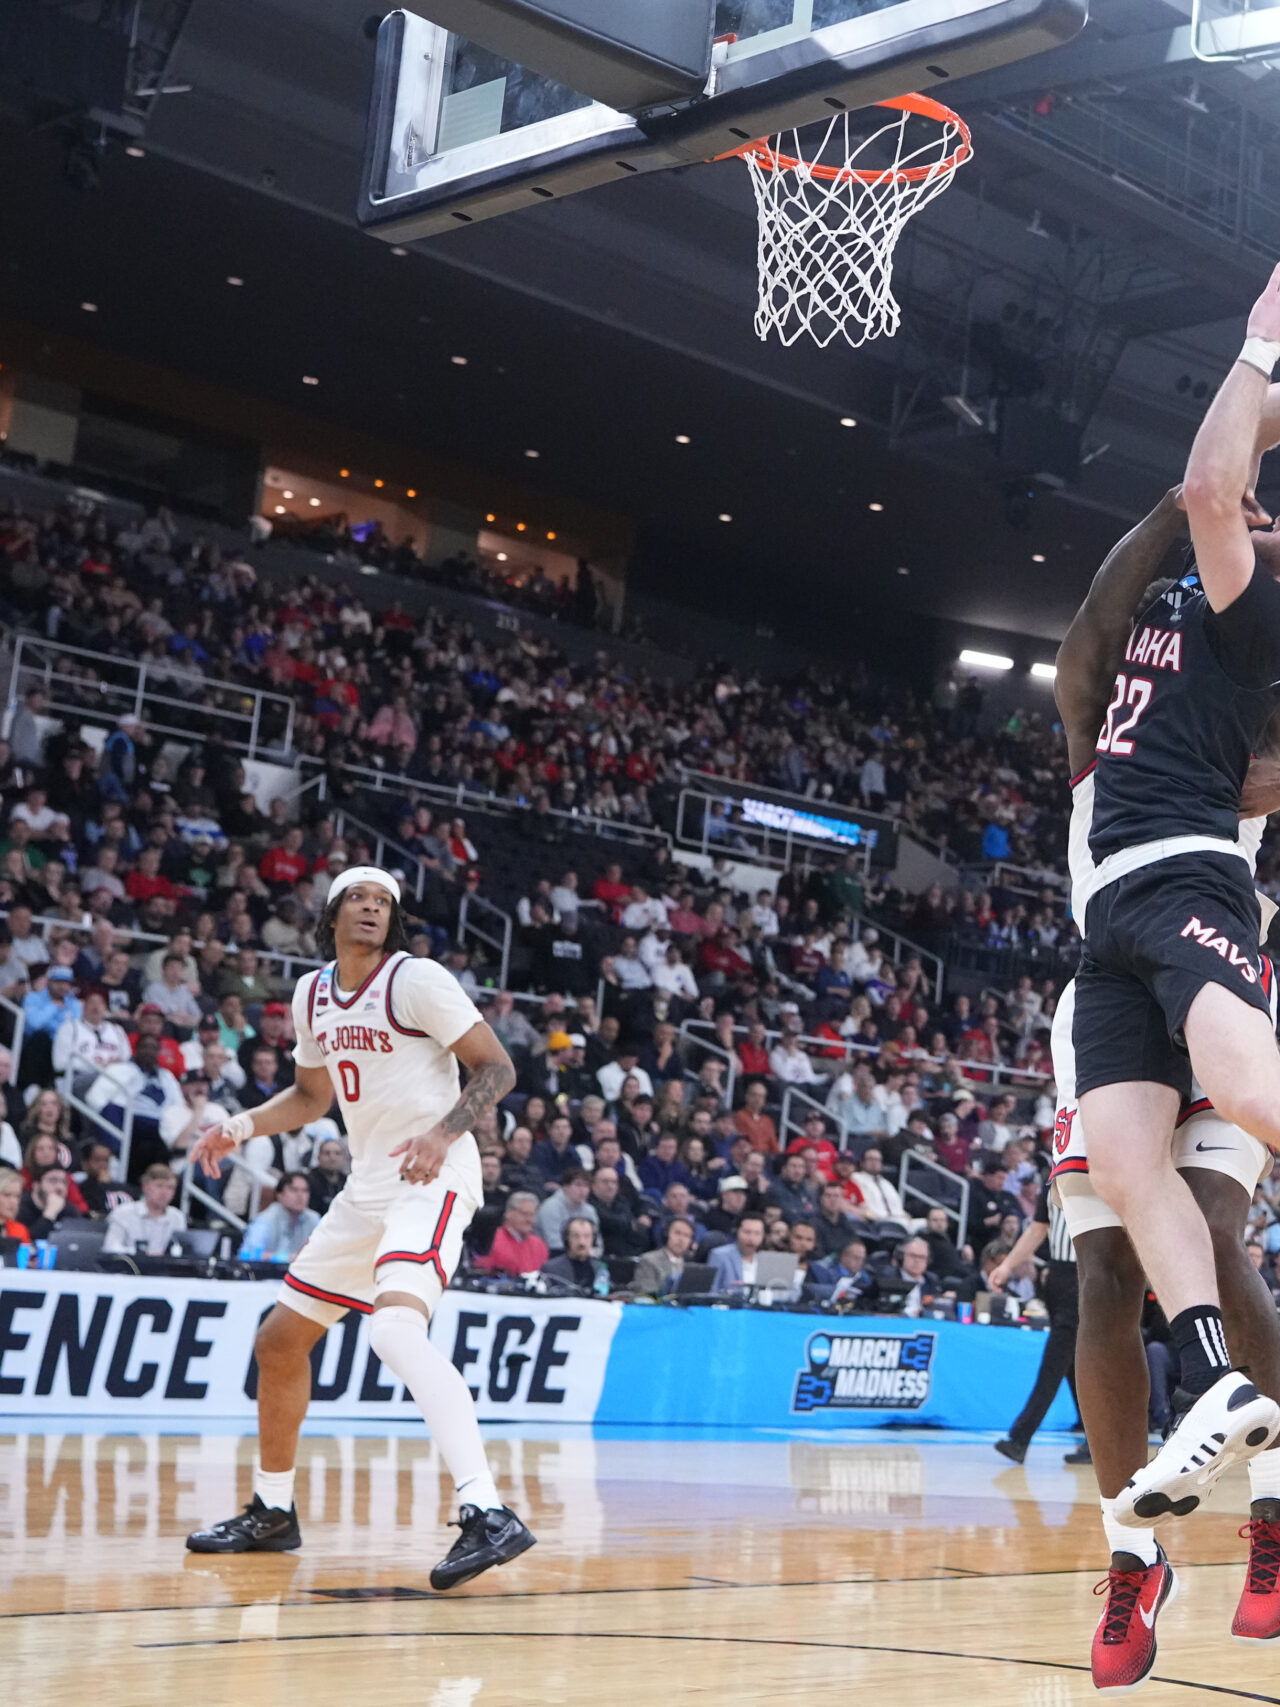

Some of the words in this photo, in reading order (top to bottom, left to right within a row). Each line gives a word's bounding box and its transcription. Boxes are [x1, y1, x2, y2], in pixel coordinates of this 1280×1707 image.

[1180, 916, 1258, 984] MAVS
[331, 1025, 394, 1053] JOHN'S
[338, 1060, 360, 1102] 0
[828, 1337, 902, 1368] MARCH
[833, 1368, 929, 1399] MADNESS
